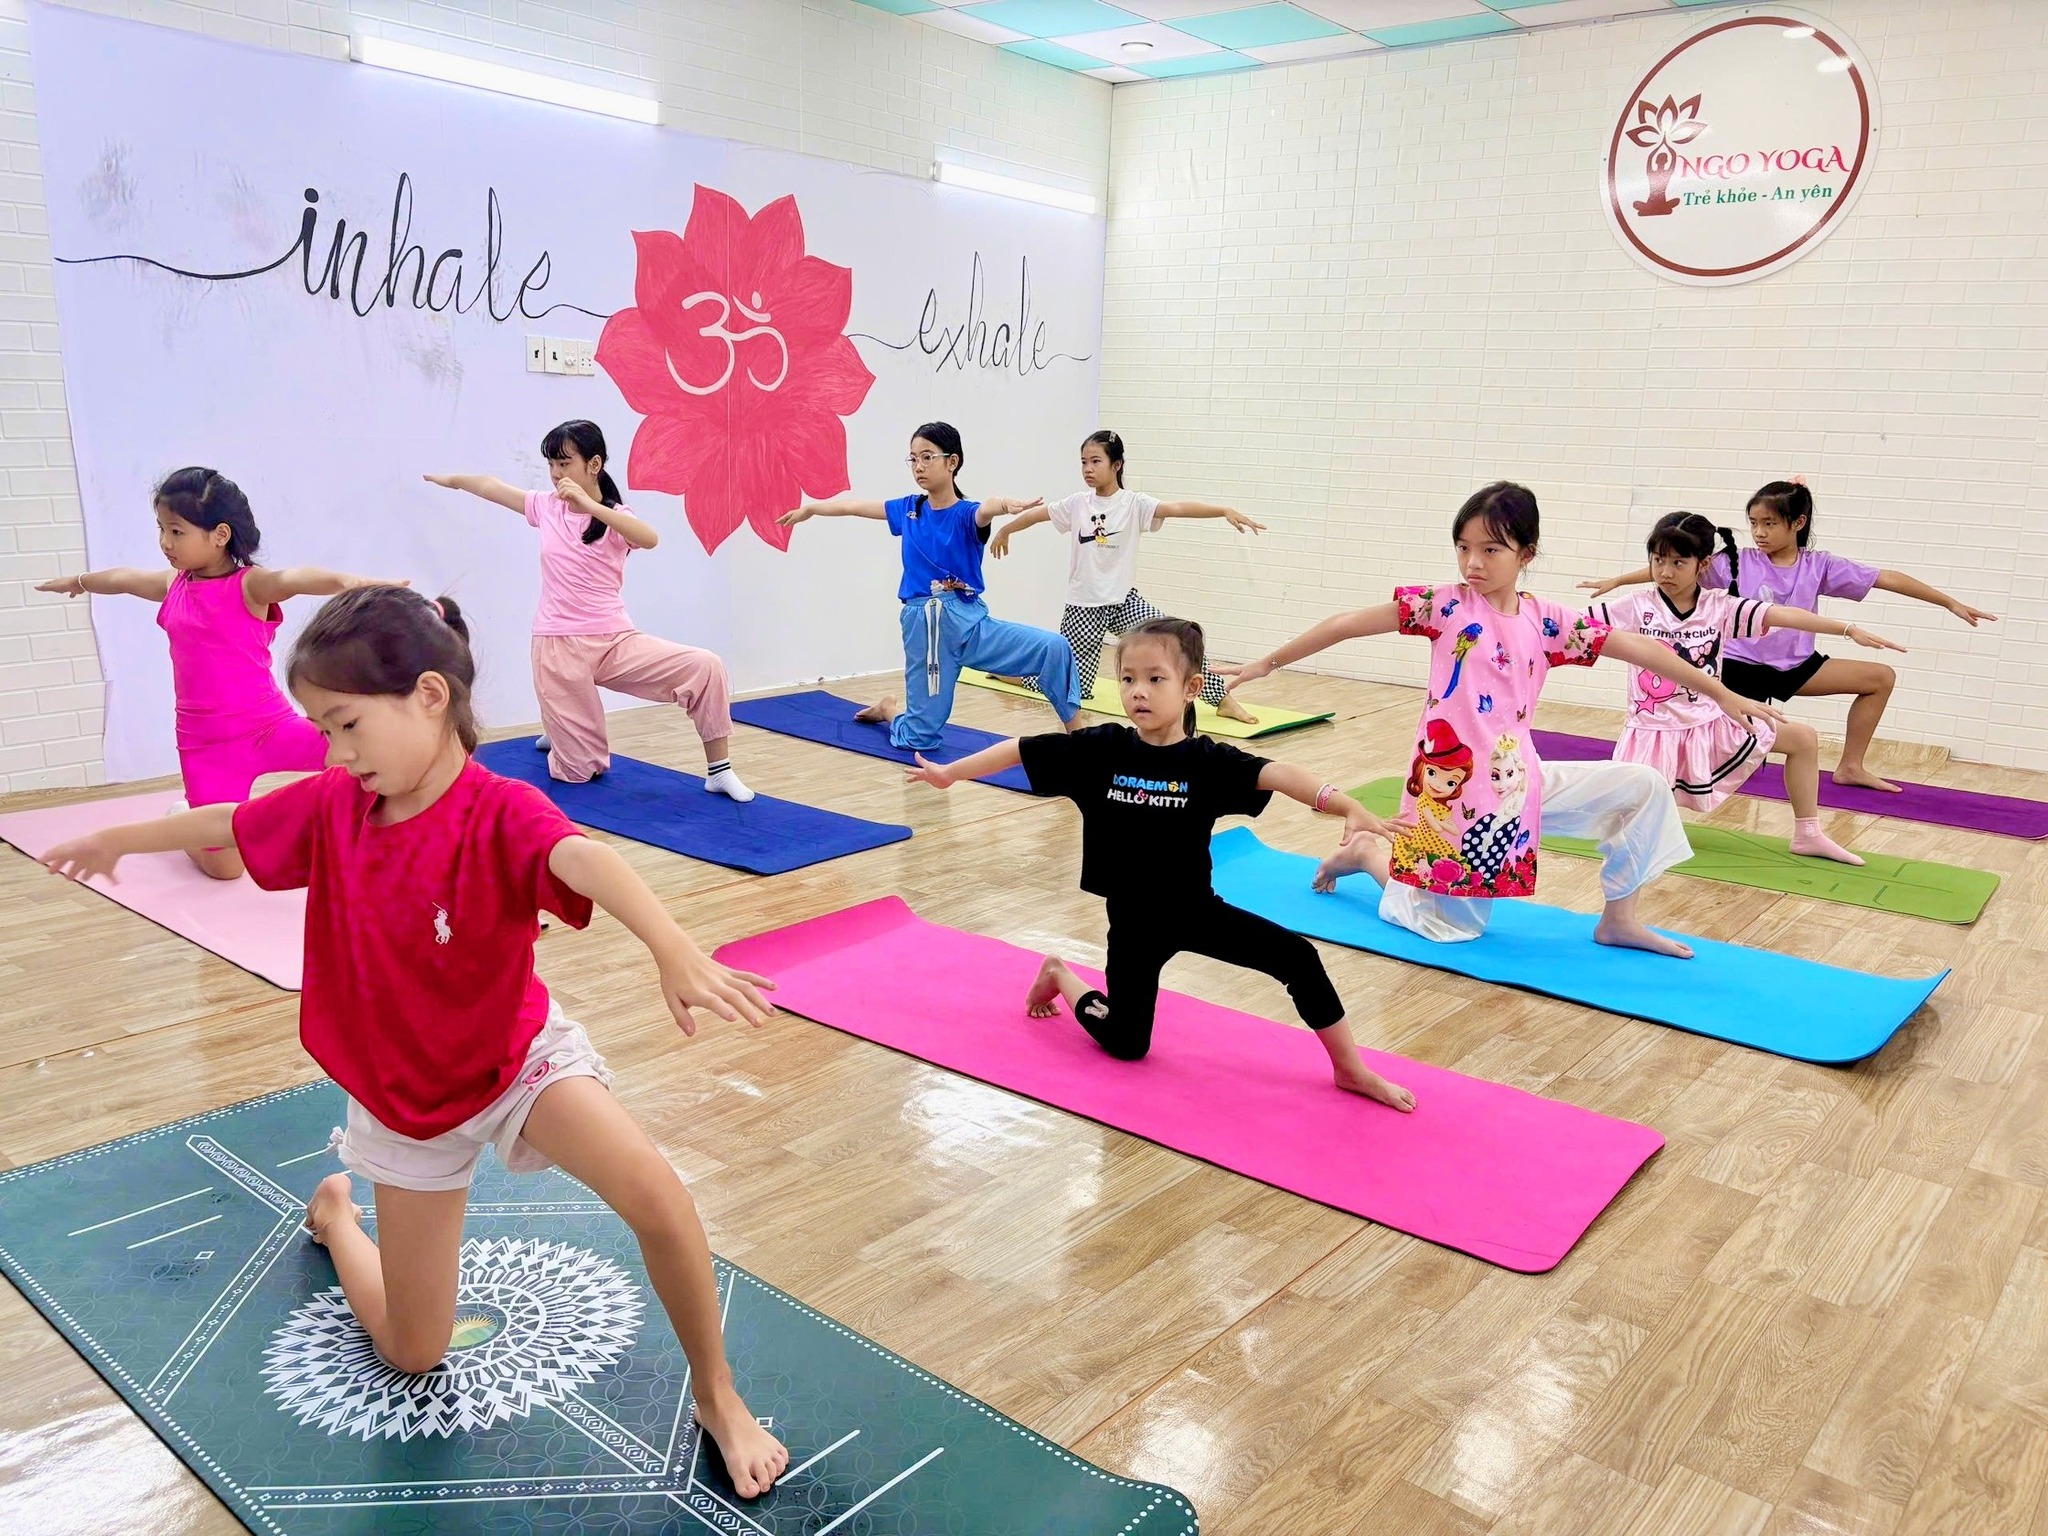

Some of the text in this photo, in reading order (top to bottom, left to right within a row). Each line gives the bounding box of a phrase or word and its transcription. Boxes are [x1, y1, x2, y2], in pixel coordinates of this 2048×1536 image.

[1677, 145, 1851, 180] NGO YOGA
[1683, 189, 1711, 206] Trẻ
[1716, 187, 1757, 204] khỏe
[1771, 186, 1795, 200] An
[1800, 184, 1832, 202] yên
[298, 171, 570, 322] inhale
[908, 251, 1055, 377] exhale
[1107, 788, 1188, 808] HELLO KITTY
